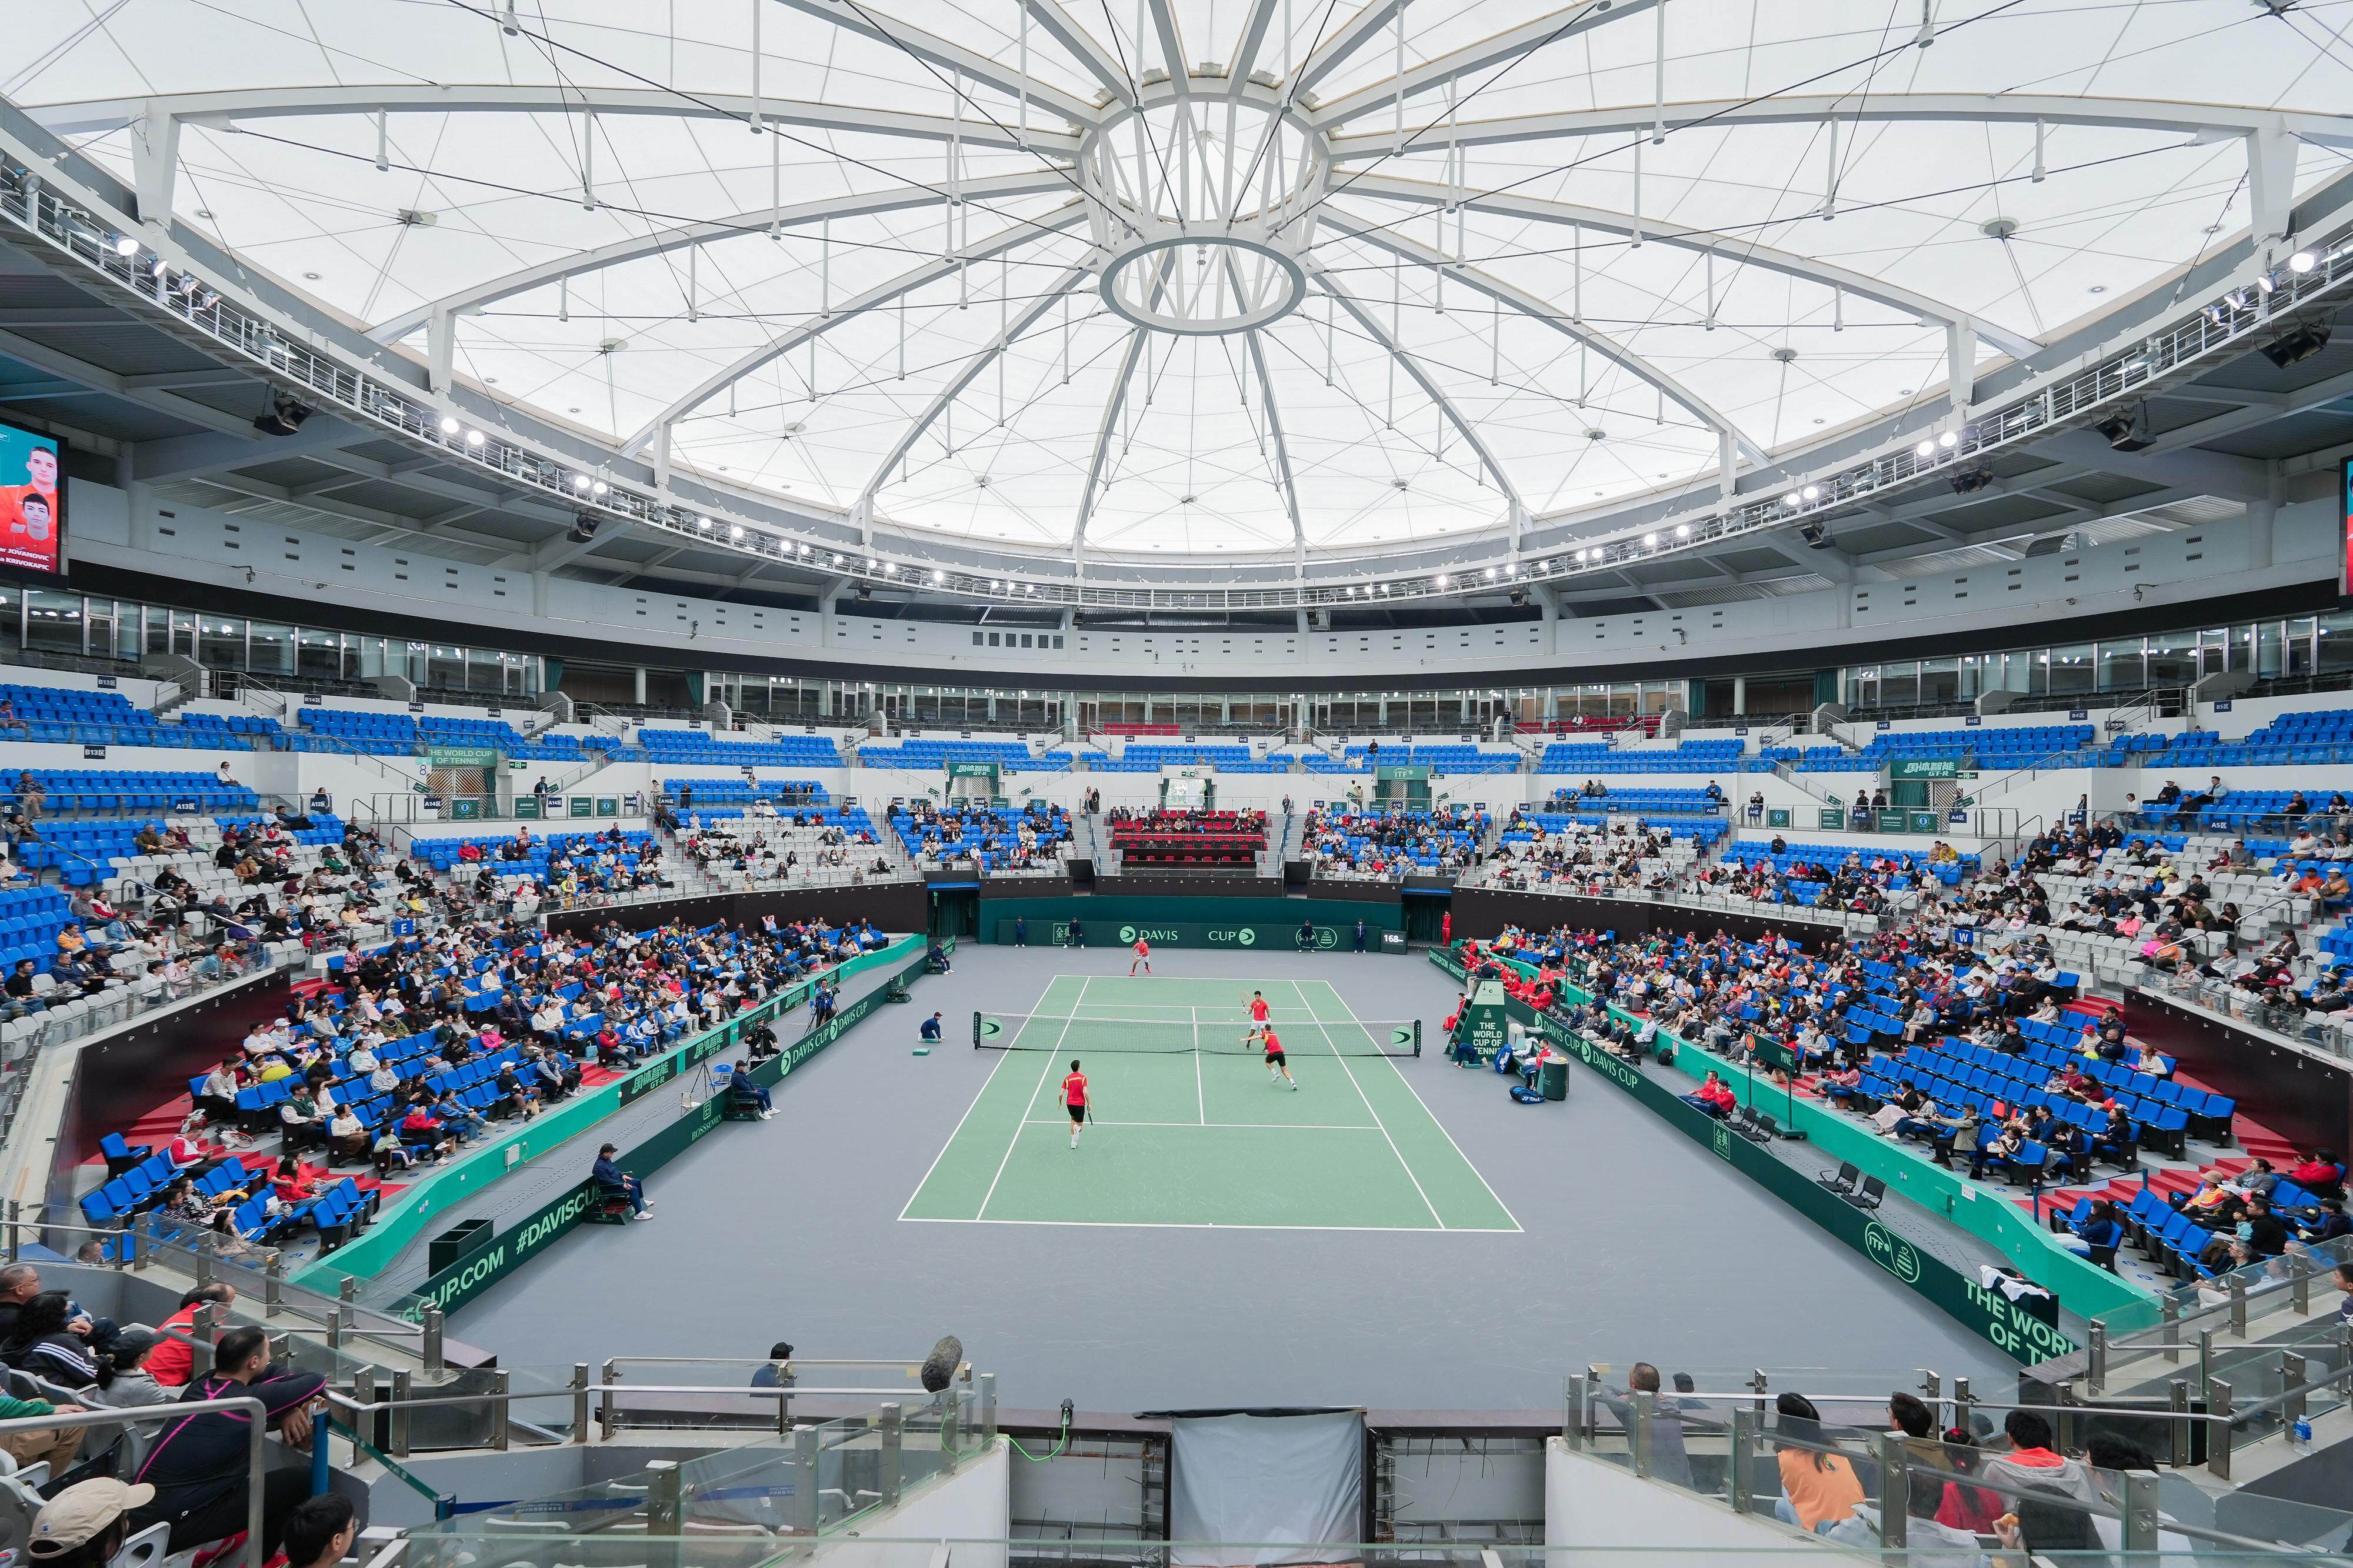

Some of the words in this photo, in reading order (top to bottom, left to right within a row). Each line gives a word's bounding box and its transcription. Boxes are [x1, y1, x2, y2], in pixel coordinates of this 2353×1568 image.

[7, 549, 49, 561] JOVANOVIC
[6, 558, 49, 571] KRIVOKAPIC
[420, 765, 426, 775] 8
[1903, 762, 1955, 773] 国体智能
[1873, 772, 1878, 782] 3
[401, 923, 407, 933] E
[1140, 930, 1178, 940] DAVIS
[1208, 930, 1236, 941] CUP
[1384, 935, 1399, 943] 168
[1959, 933, 1968, 942] W
[839, 1009, 855, 1031] DAVIS
[856, 1002, 868, 1017] CUP
[1544, 1020, 1563, 1042] DAVIS
[1565, 1033, 1580, 1052] CUP
[708, 1045, 721, 1056] GT-R
[793, 1038, 814, 1063] DAVIS
[815, 1028, 829, 1047] CUP
[1781, 1051, 1792, 1066] MNE
[1593, 1050, 1617, 1076] DAVIS
[1619, 1067, 1638, 1088] CUP
[650, 1076, 665, 1089] GT-R
[1869, 1235, 1883, 1251] ITF
[1964, 1277, 2005, 1320] THE
[1989, 1322, 2020, 1352] OF
